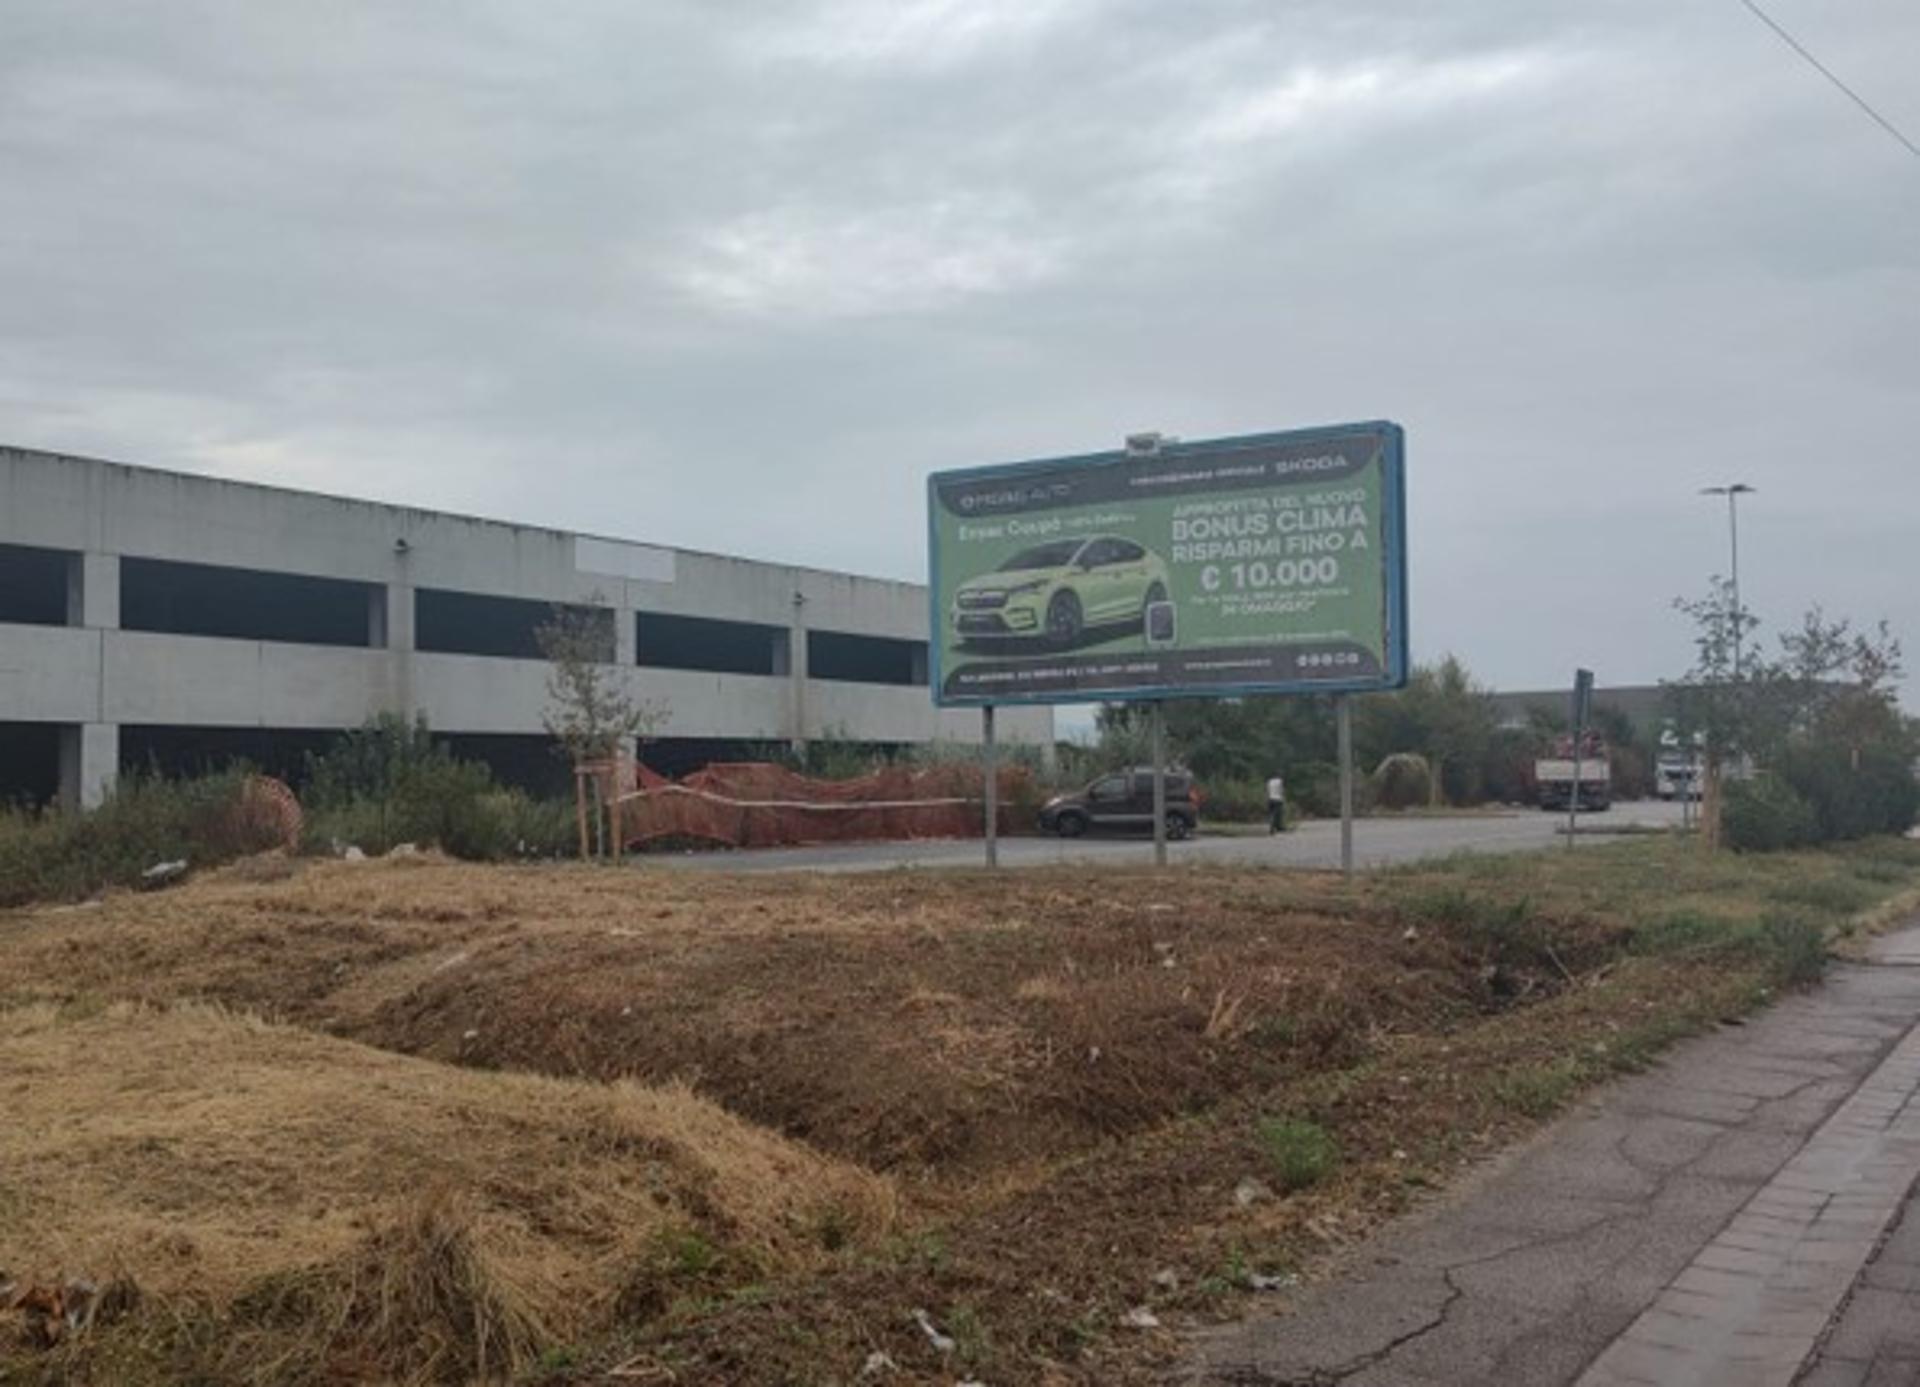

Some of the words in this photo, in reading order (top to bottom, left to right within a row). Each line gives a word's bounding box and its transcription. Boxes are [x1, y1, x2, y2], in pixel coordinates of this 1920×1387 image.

[1171, 513, 1268, 541] BONUS
[1276, 503, 1368, 533] CLIMA
[1172, 537, 1280, 563] RISPARMI
[1286, 531, 1346, 555] FINO
[1351, 529, 1368, 550] A
[1201, 564, 1220, 591] €
[1231, 556, 1340, 589] 10.000
